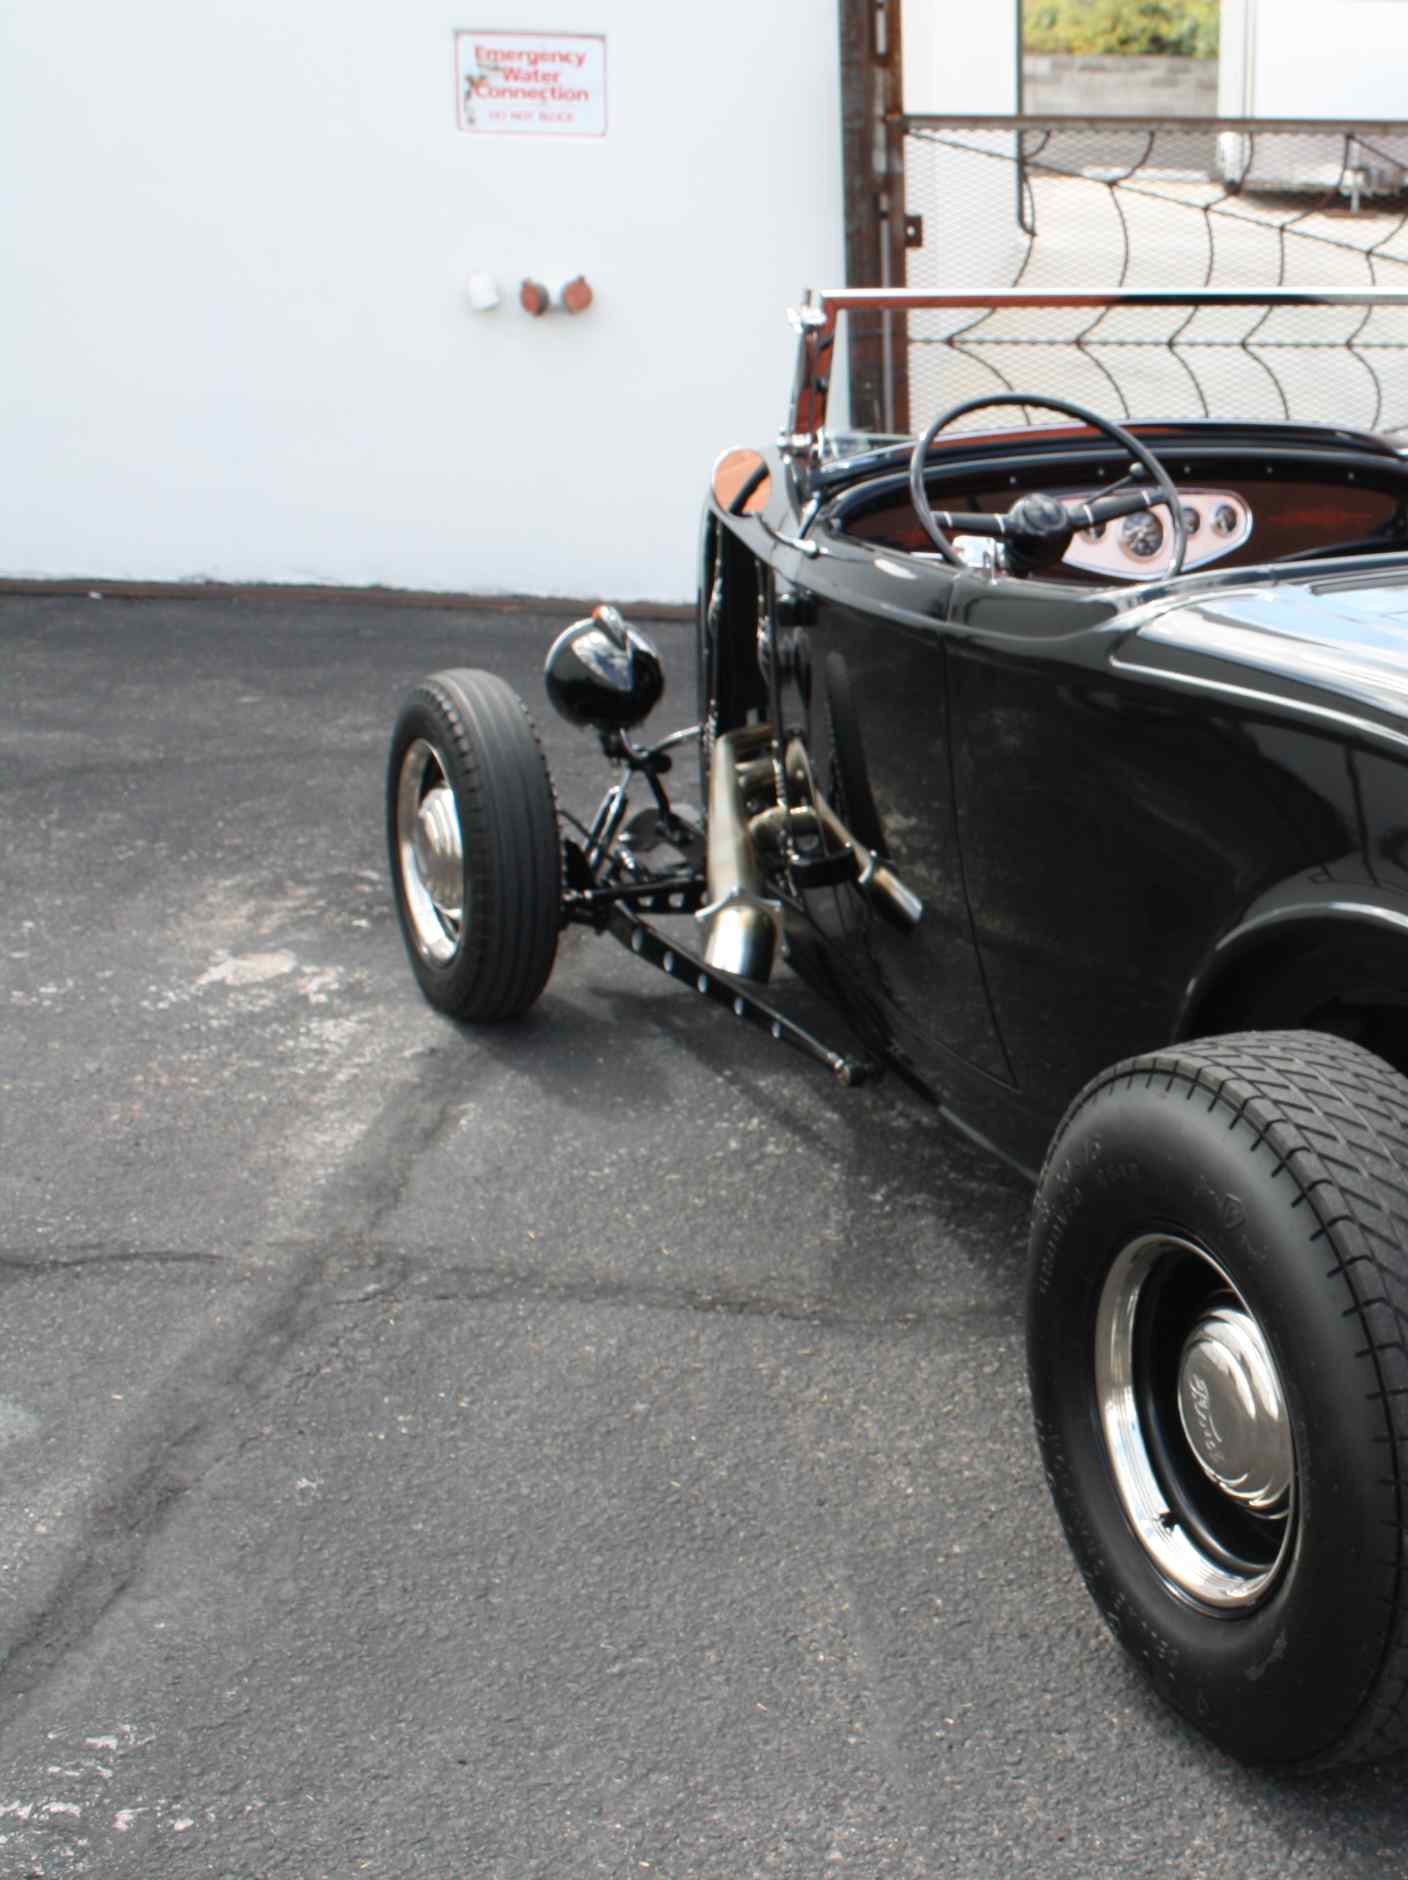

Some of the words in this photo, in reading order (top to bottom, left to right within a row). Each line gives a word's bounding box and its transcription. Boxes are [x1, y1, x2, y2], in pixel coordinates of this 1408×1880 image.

[475, 45, 587, 69] Emergency
[502, 67, 561, 83] Water
[474, 81, 590, 101] Connection
